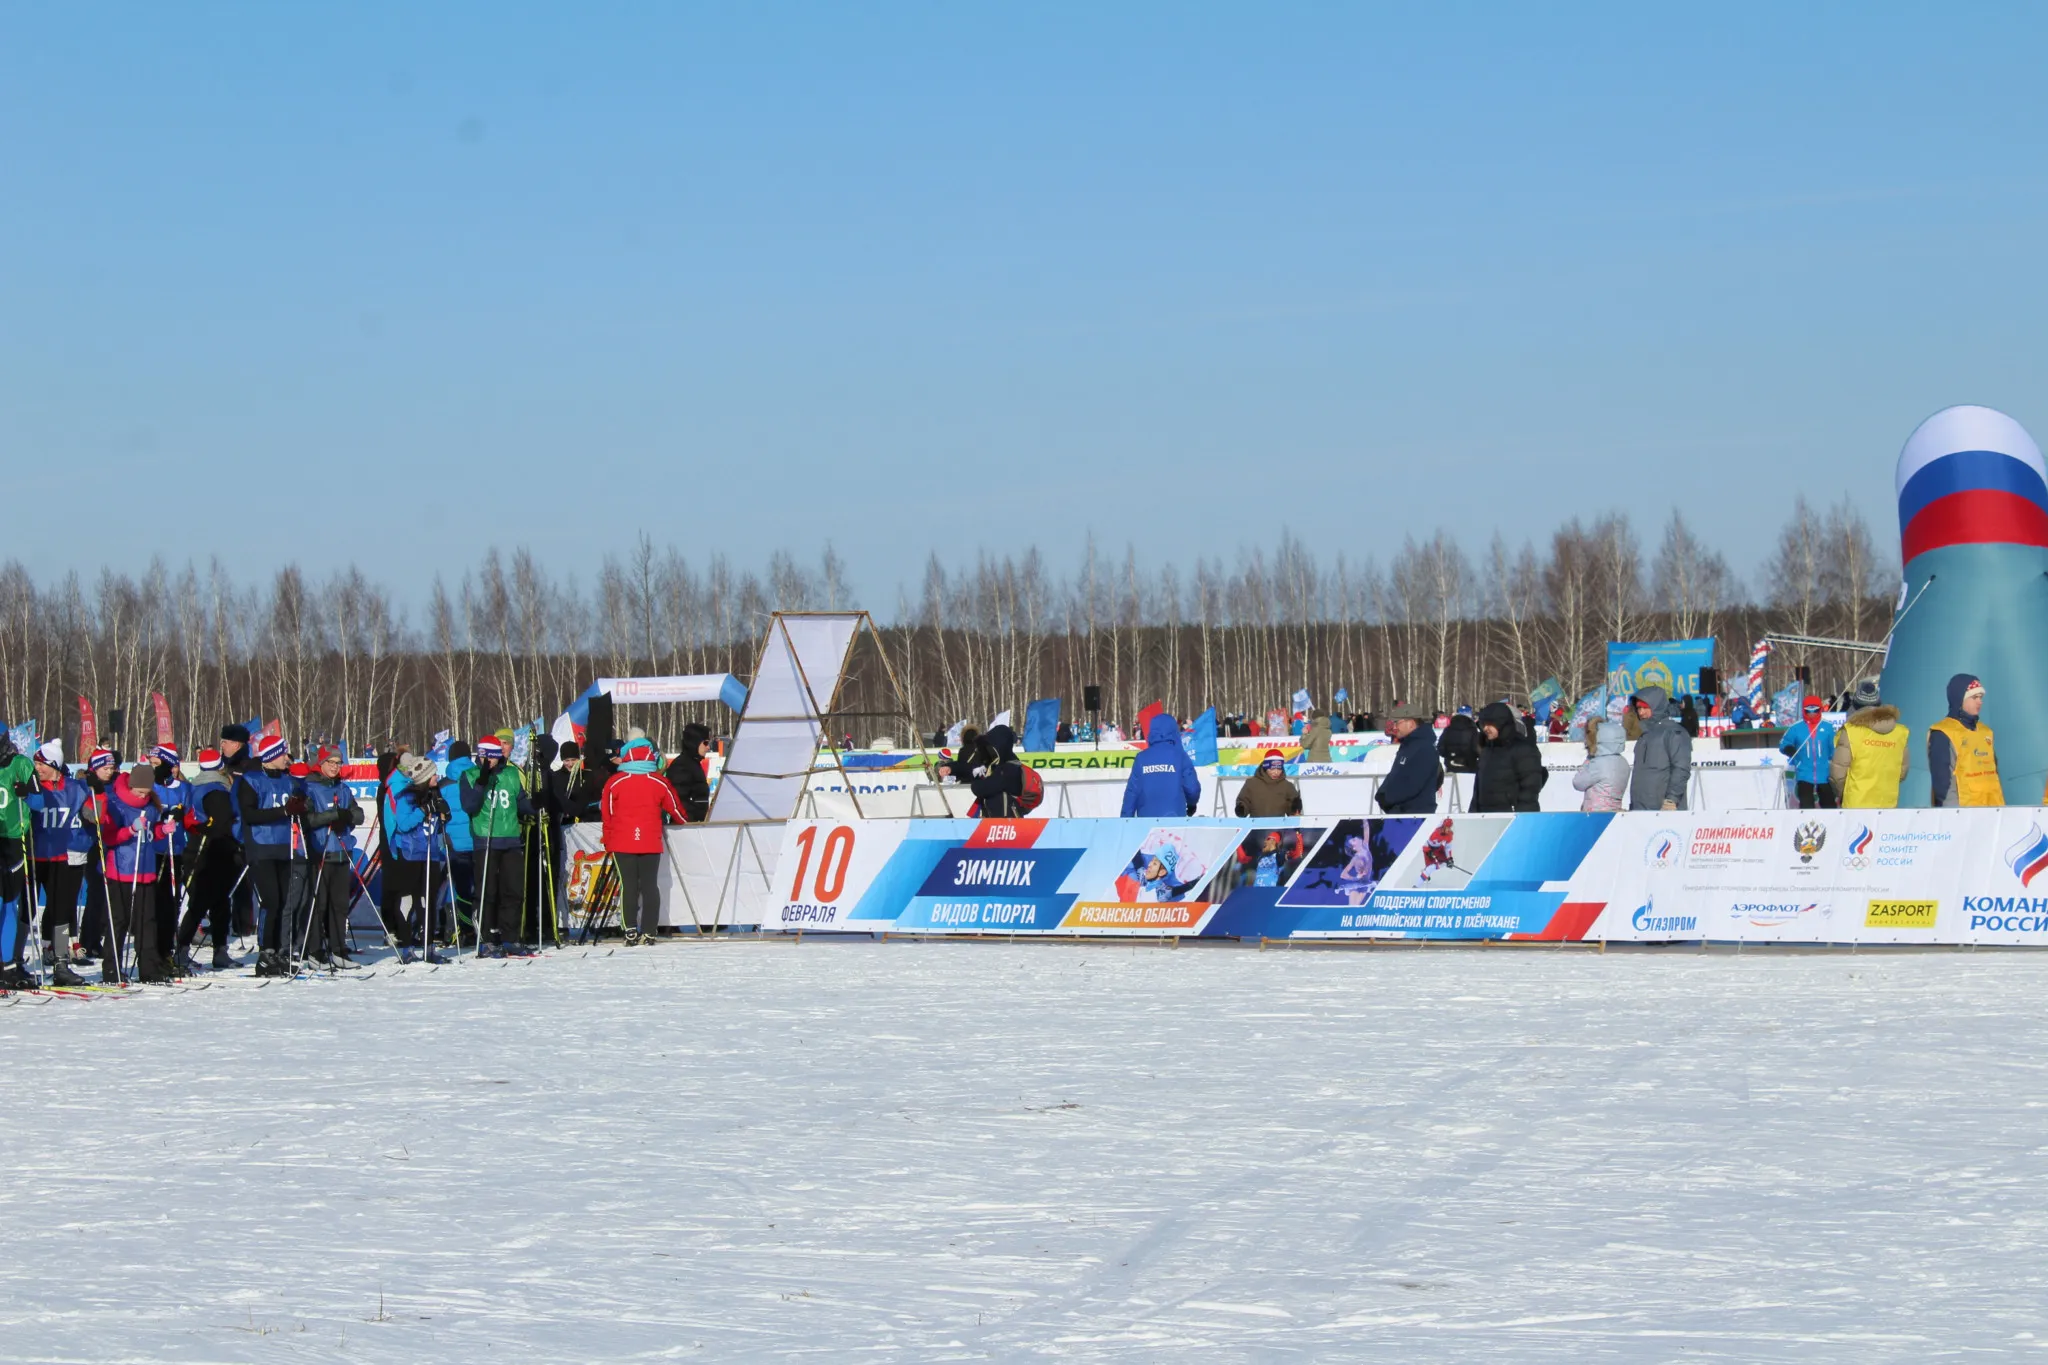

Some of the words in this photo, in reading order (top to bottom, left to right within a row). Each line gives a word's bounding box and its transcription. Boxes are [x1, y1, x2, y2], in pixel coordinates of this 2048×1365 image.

[616, 681, 639, 696] ГТО
[1677, 673, 1699, 695] ЛЕ
[1142, 764, 1176, 774] RUSSIA
[1701, 760, 1737, 768] гонка
[41, 806, 71, 828] 117
[986, 825, 1017, 843] ДЕНЬ
[1695, 824, 1774, 841] ОЛИМПИЙСКАЯ
[1880, 831, 1952, 842] ОЛИМПИЙСКИЙ
[1691, 842, 1731, 855] СТРАНА
[1878, 845, 1918, 854] КОМИТЕТ
[790, 825, 856, 903] 10
[1876, 857, 1913, 866] РОССИИ
[954, 859, 1036, 886] ЗИМНИХ
[1373, 895, 1425, 910] ПОДДЕРЖИ
[1427, 896, 1491, 910] СПОРТСМЕНОВ
[1730, 903, 1800, 913] АЭРОФЛОТ
[1871, 904, 1934, 917] ZASPORT
[1962, 896, 2048, 914] КОМАН
[781, 905, 837, 923] ФЕВРАЛЯ
[931, 903, 979, 926] ВИДОВ
[981, 903, 1037, 924] СПОРТА
[1079, 906, 1142, 923] РЯЗАНСКАЯ
[1143, 906, 1190, 923] ОБЛАСТЬ
[1341, 915, 1353, 928] НА
[1355, 912, 1421, 928] ОЛИМПИЙСКИХ
[1423, 915, 1453, 928] ИГРАХ
[1454, 915, 1461, 928] В
[1463, 913, 1520, 929] ПХЁНЧХАНЕ!
[1650, 916, 1697, 932] ГАЗПРОМ
[1970, 915, 2048, 932] РОССИ
